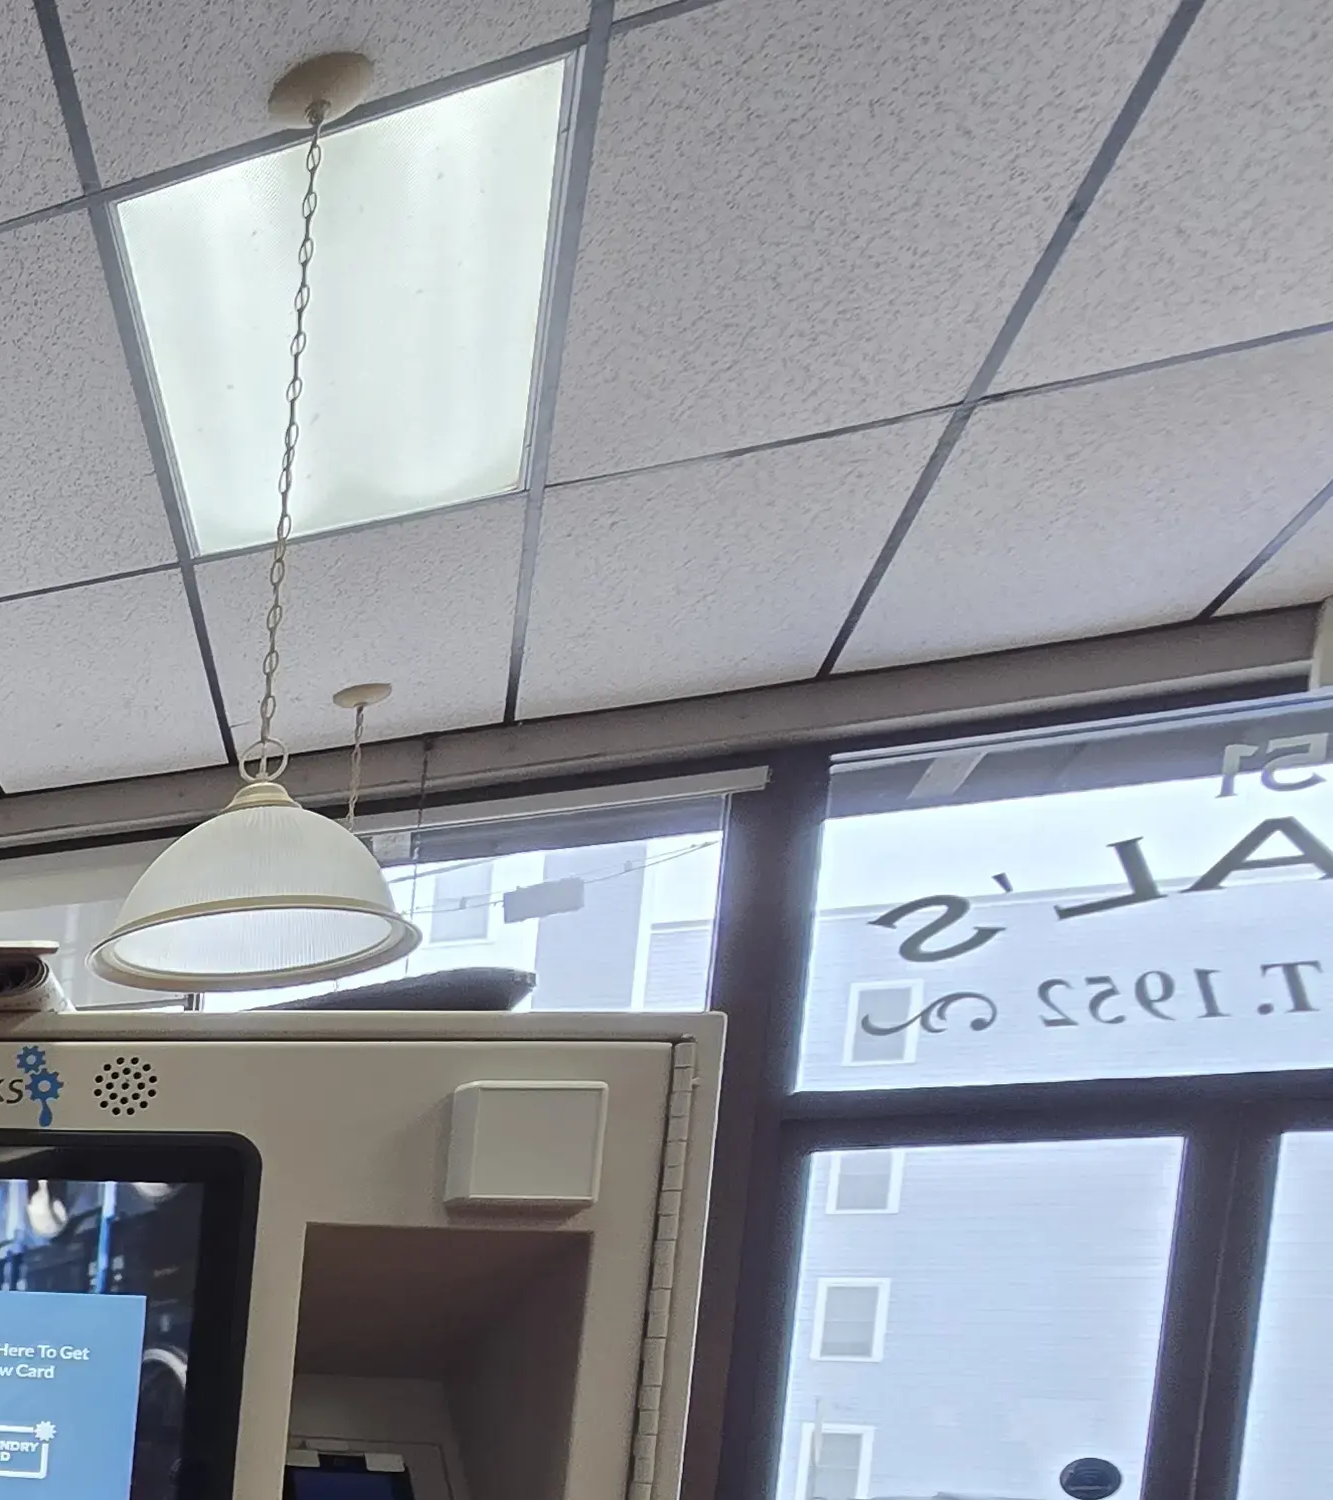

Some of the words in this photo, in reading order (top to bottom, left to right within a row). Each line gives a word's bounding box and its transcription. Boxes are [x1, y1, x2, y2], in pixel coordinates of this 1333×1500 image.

[37, 1344, 57, 1359] To
[59, 1345, 90, 1361] Get
[16, 1364, 55, 1379] Card
